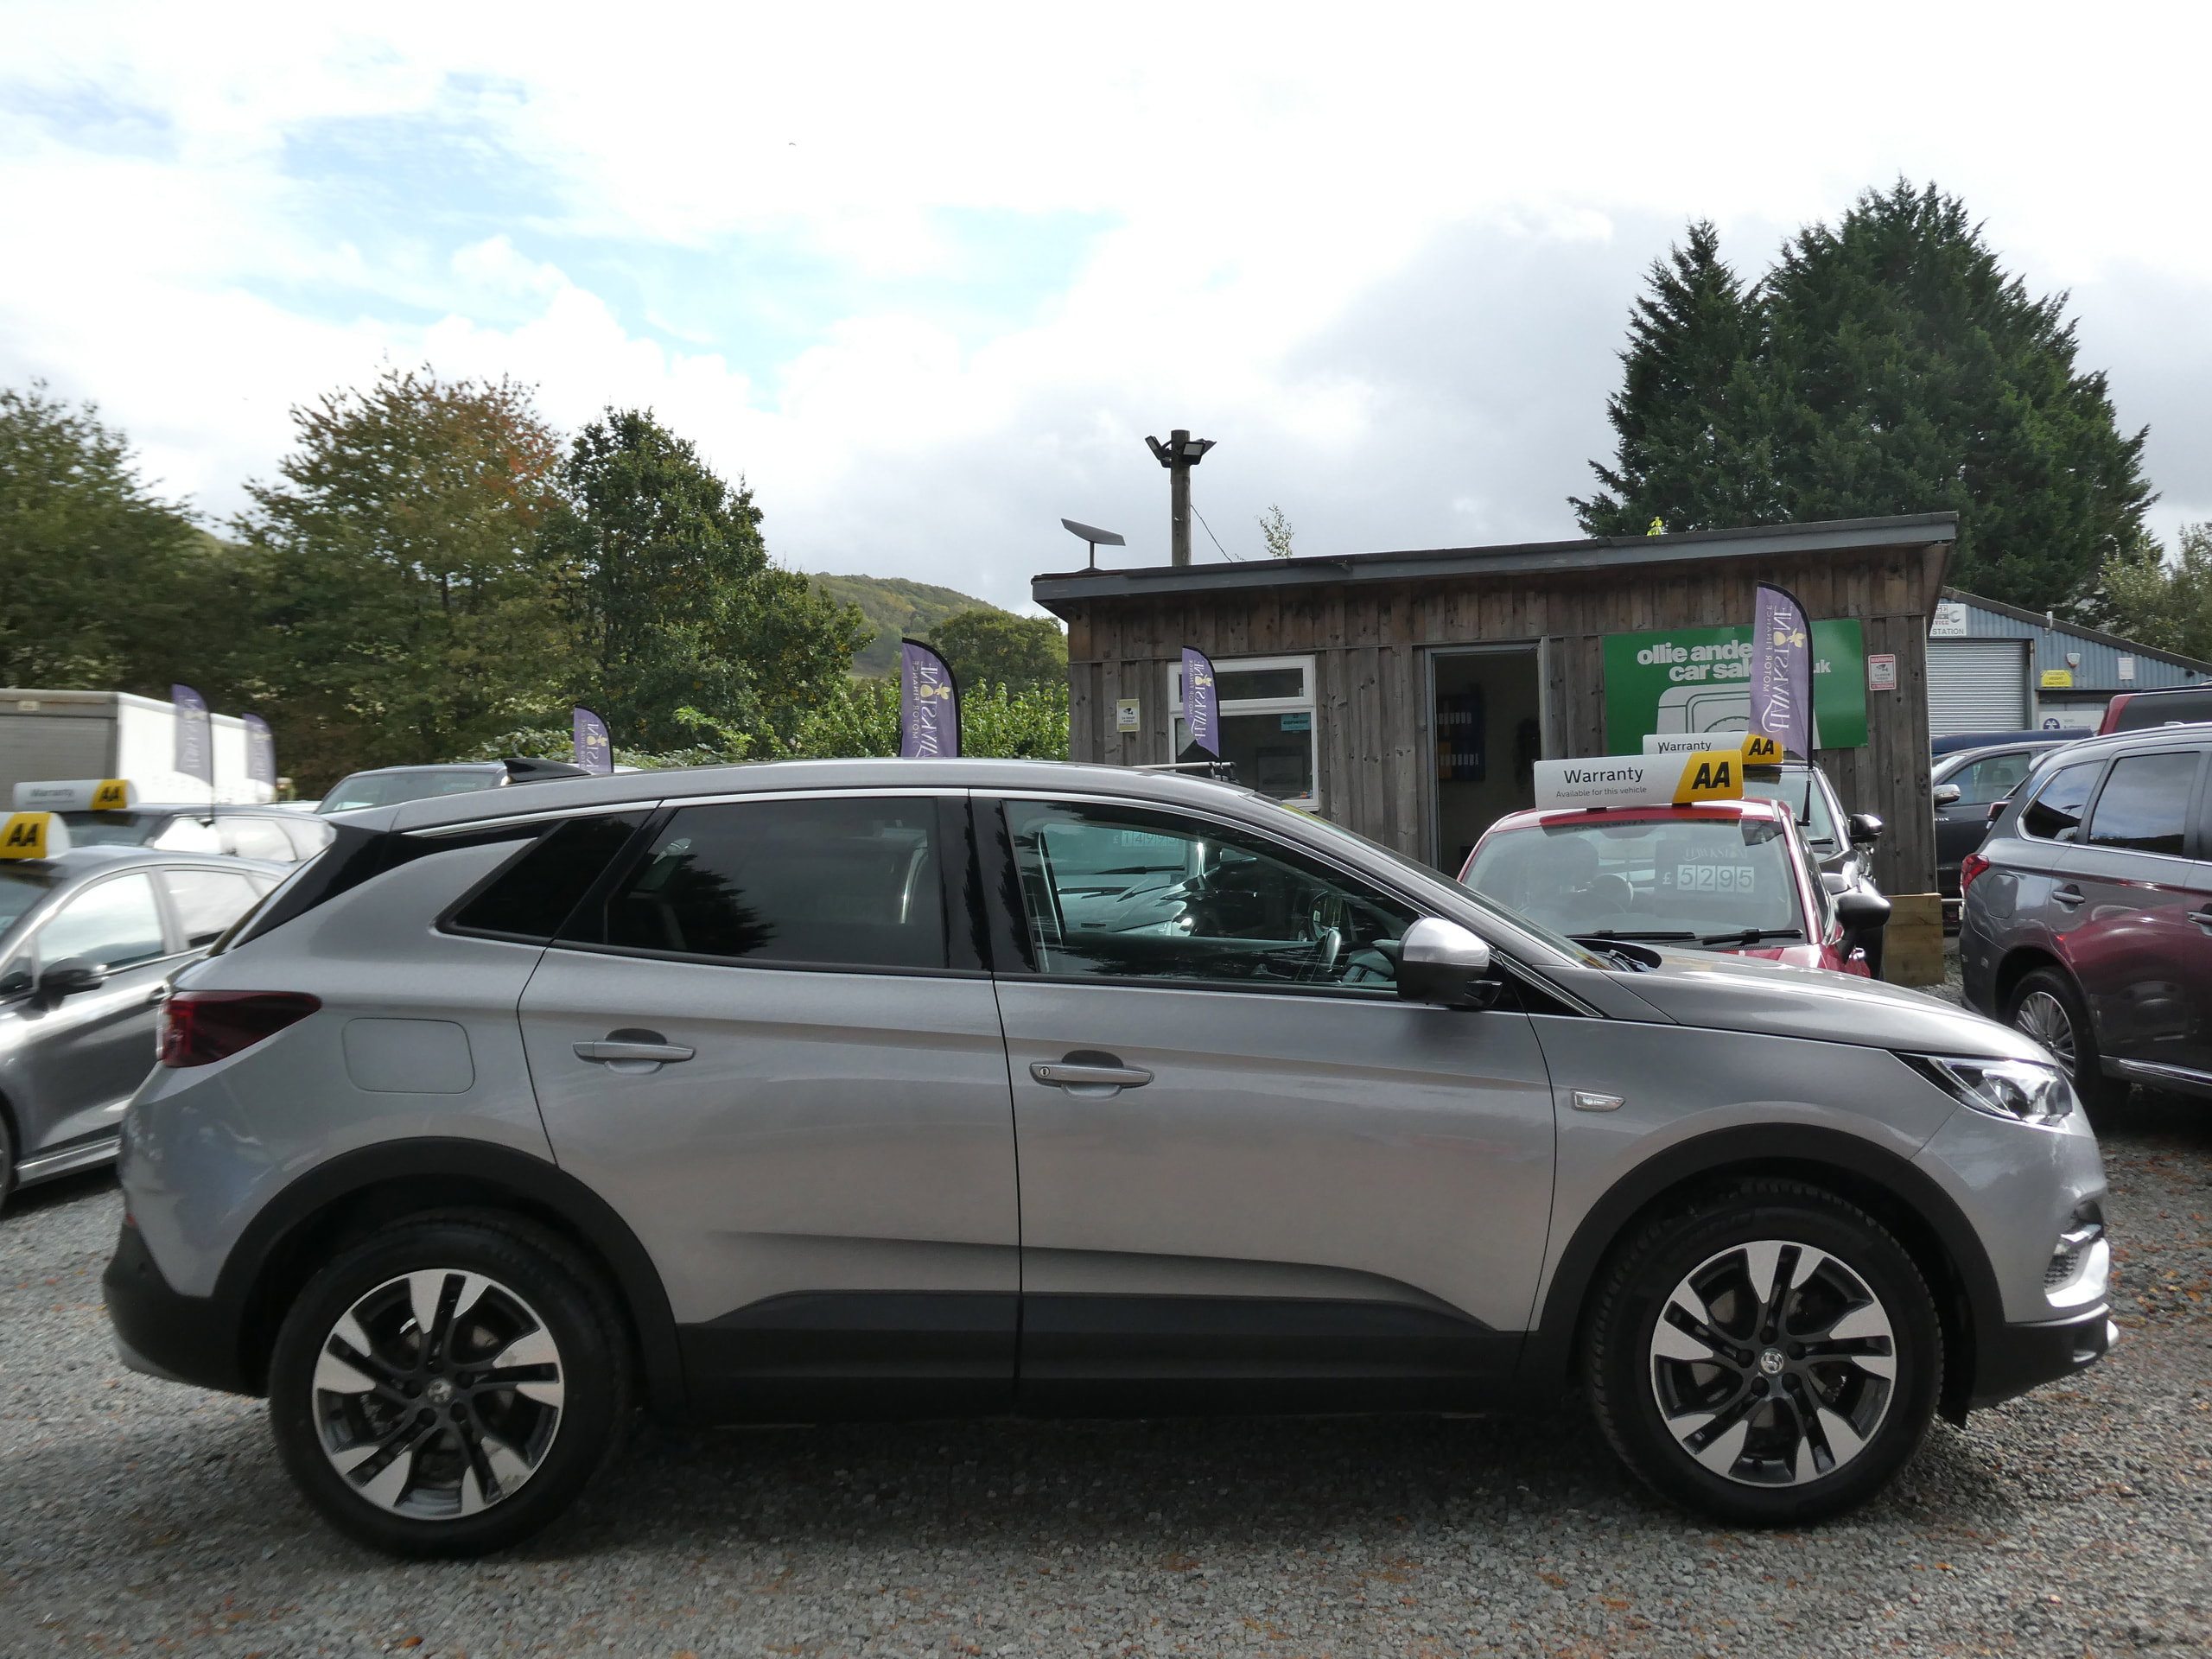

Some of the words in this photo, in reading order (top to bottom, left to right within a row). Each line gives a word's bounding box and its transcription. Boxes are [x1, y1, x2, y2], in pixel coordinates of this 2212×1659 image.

[1637, 642, 1688, 665] ollie
[1690, 639, 1753, 662] ande
[1669, 664, 1711, 682] car
[1713, 658, 1752, 680] sal
[1657, 741, 1712, 753] Warranty
[1748, 738, 1774, 756] AA
[1563, 766, 1644, 785] Warranty
[1691, 760, 1731, 790] AA
[99, 786, 122, 802] AA
[1555, 789, 1591, 799] Available
[1604, 787, 1619, 796] this
[1619, 785, 1647, 796] vehicle
[5, 823, 39, 847] AA
